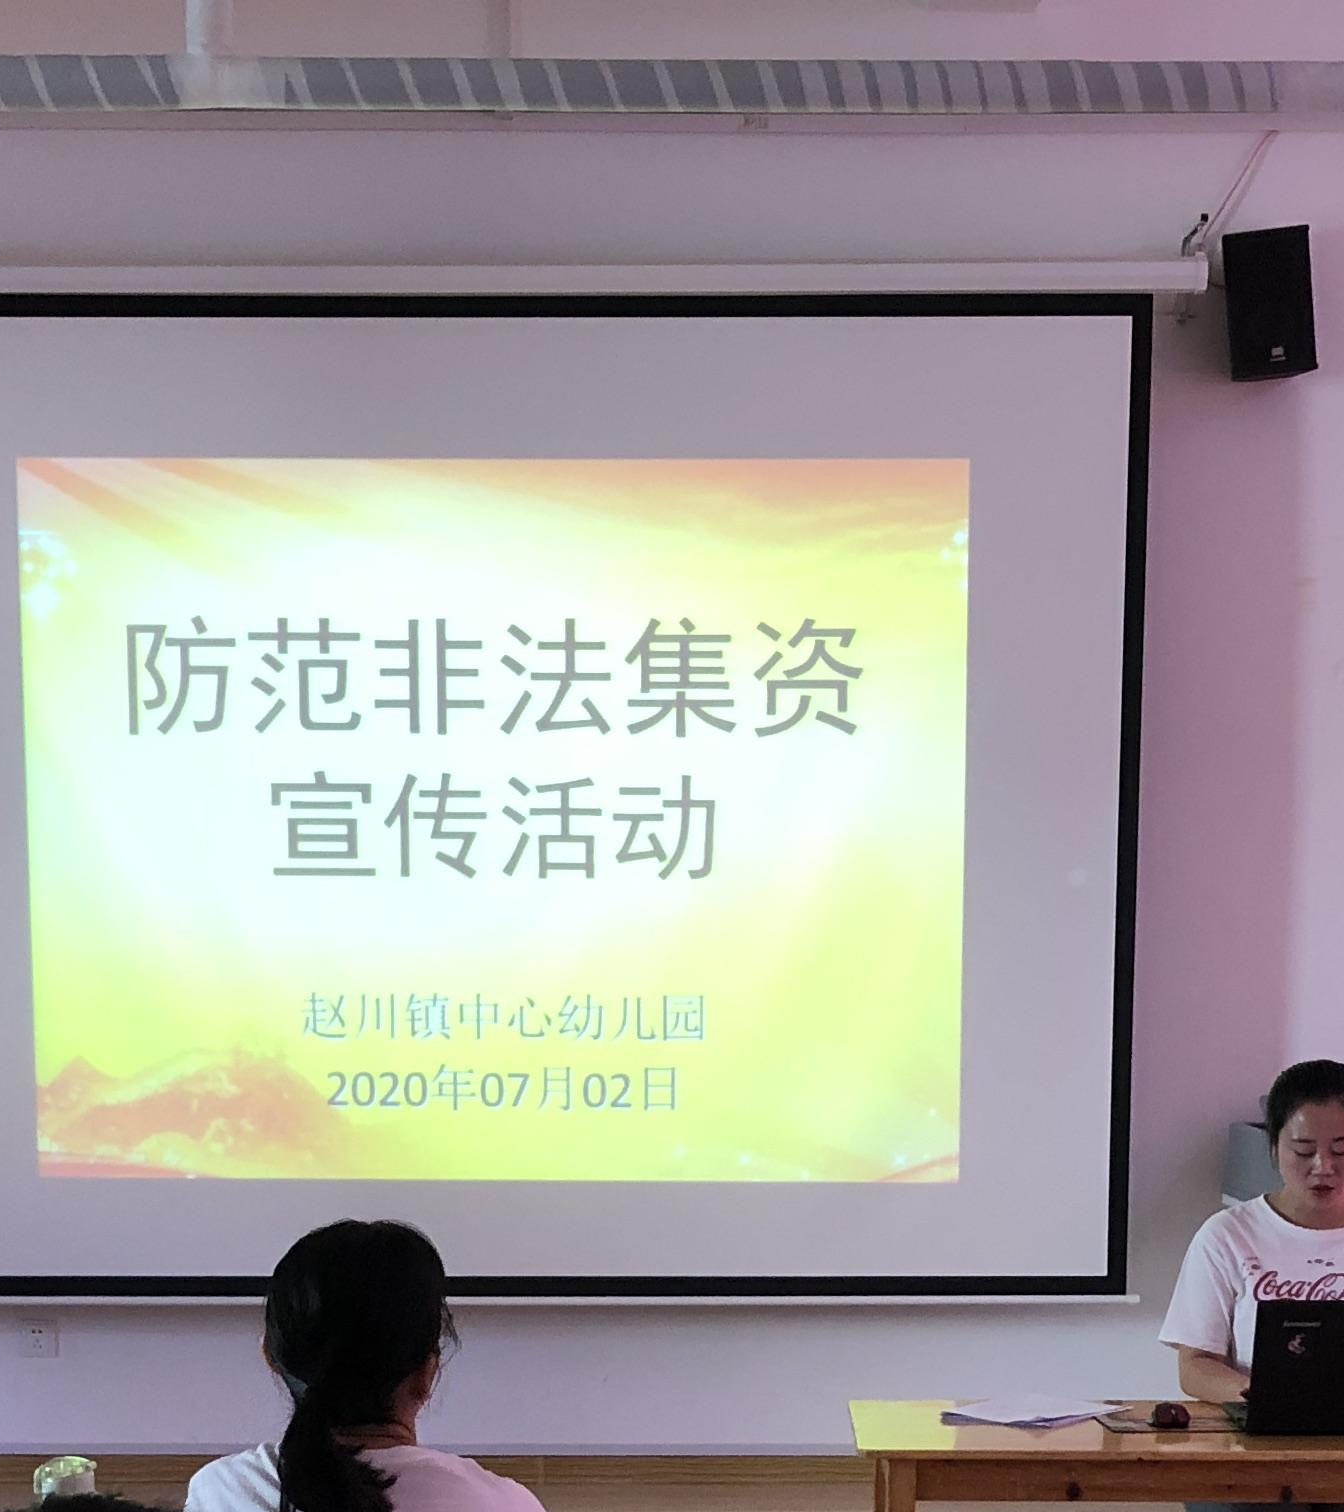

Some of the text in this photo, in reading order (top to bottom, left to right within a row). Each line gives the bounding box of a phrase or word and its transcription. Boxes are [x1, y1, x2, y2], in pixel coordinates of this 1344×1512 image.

[125, 616, 866, 738] 防范非法集资
[269, 771, 717, 881] 宣传活动
[300, 993, 706, 1042] 赵川镇中心幼儿园
[325, 1064, 680, 1113] 2020年07月02日
